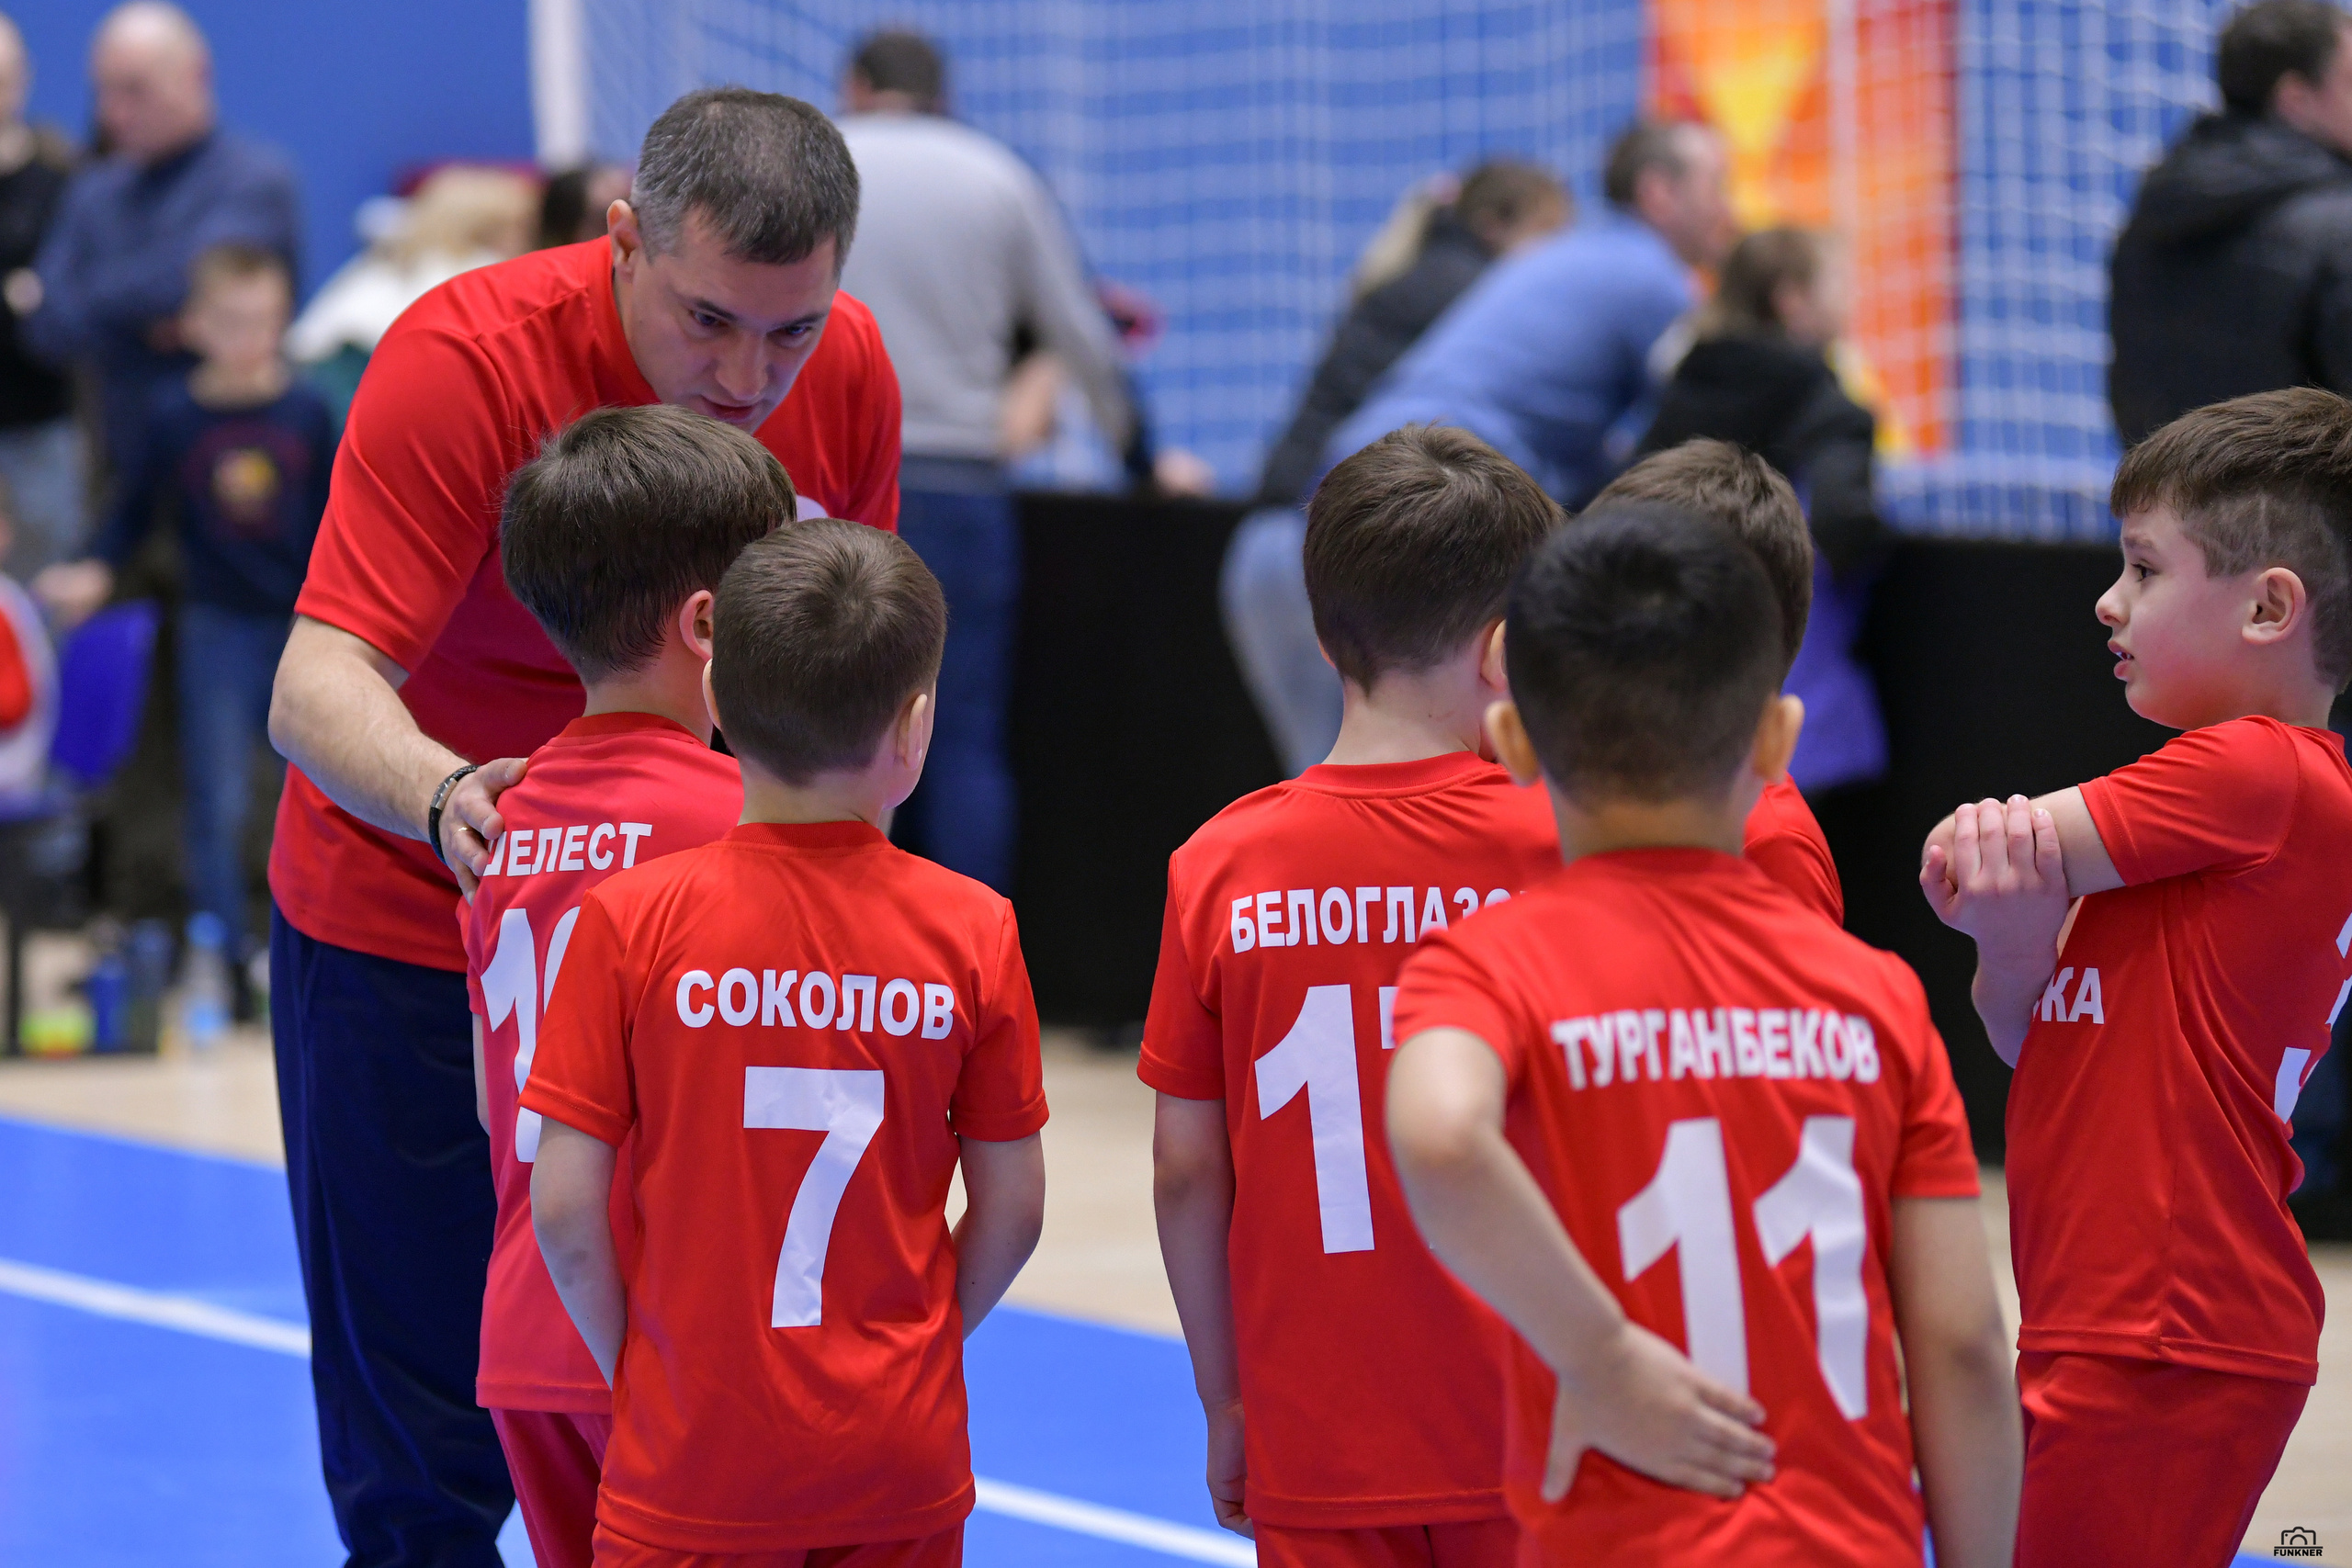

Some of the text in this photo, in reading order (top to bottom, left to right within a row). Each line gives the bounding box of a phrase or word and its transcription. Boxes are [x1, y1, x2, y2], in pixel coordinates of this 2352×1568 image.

[676, 967, 955, 1040] СОКОЛОВ
[1231, 886, 1528, 953] БЕЛОГЛАЗ
[2033, 966, 2105, 1024] КА
[481, 908, 581, 1163] 1
[1254, 984, 1399, 1255] 1
[1550, 1007, 1881, 1090] ТУРГАНБЕКОВ
[743, 1066, 884, 1328] 7
[1617, 1114, 1868, 1421] 11
